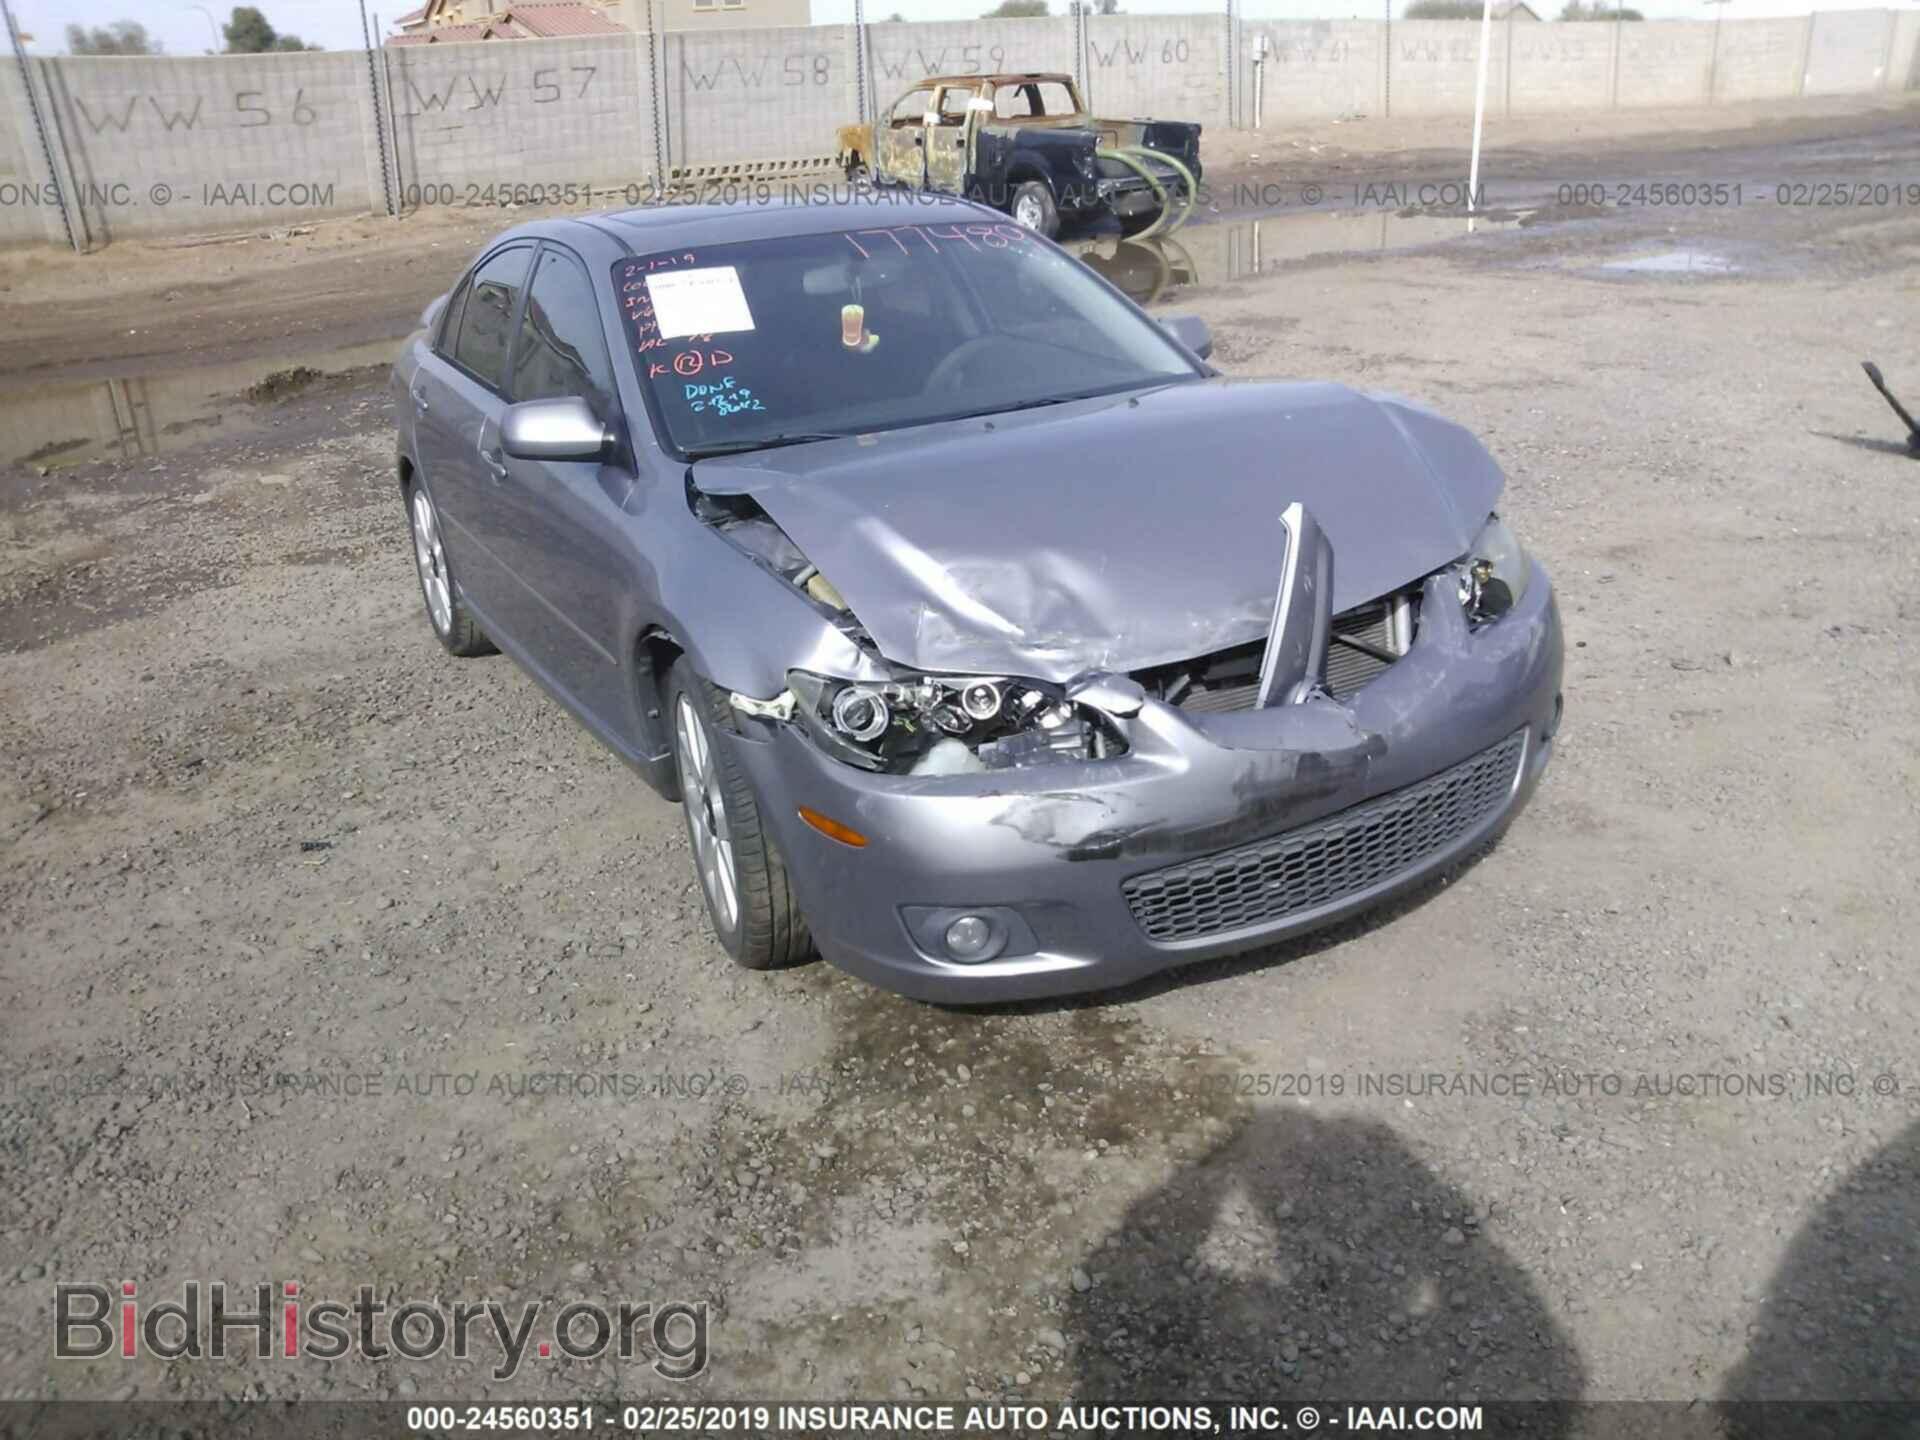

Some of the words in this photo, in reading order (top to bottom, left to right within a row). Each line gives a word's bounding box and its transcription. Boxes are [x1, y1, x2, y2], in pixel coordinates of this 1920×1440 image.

[962, 45, 1007, 75] 59
[1161, 39, 1190, 64] 60
[532, 66, 597, 104] 57
[783, 54, 832, 86] 58
[234, 89, 319, 128] 56
[711, 350, 733, 366] D
[685, 376, 737, 400] DONE
